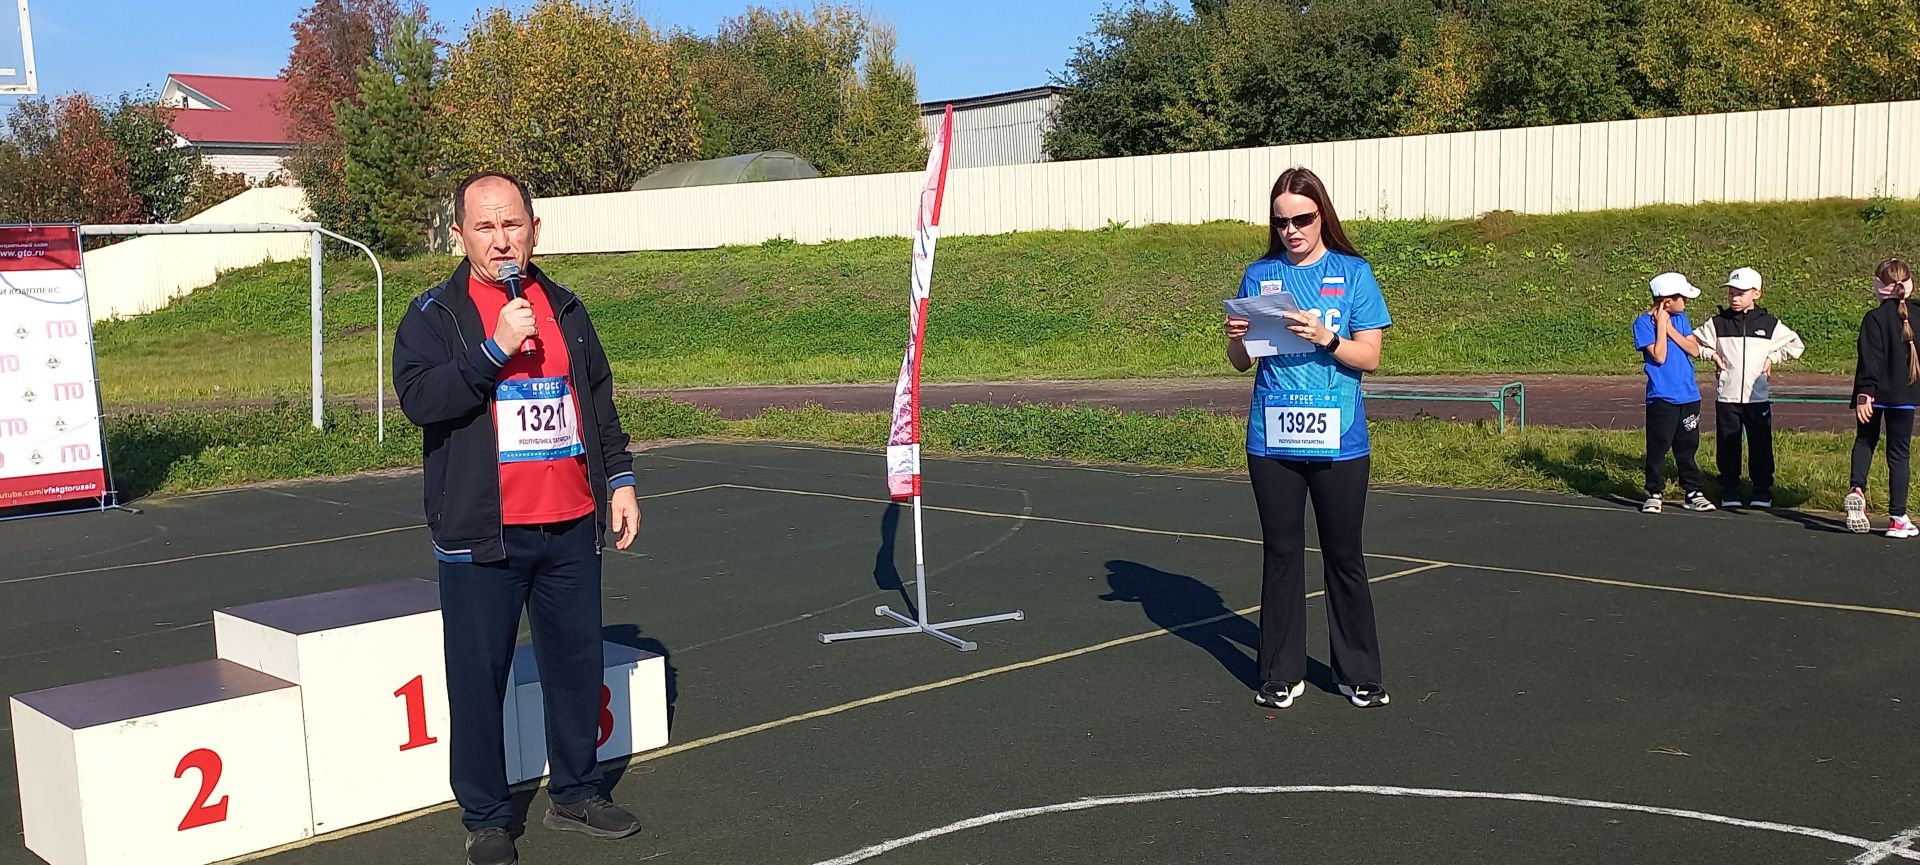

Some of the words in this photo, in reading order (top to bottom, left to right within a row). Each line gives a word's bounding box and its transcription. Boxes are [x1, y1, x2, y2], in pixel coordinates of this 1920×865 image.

[9, 286, 61, 295] КОМПЛЕКС
[532, 382, 560, 391] КРОСС
[1289, 393, 1314, 402] КРОСС
[1278, 412, 1328, 434] 13925
[393, 674, 438, 751] 1
[174, 747, 229, 831] 2
